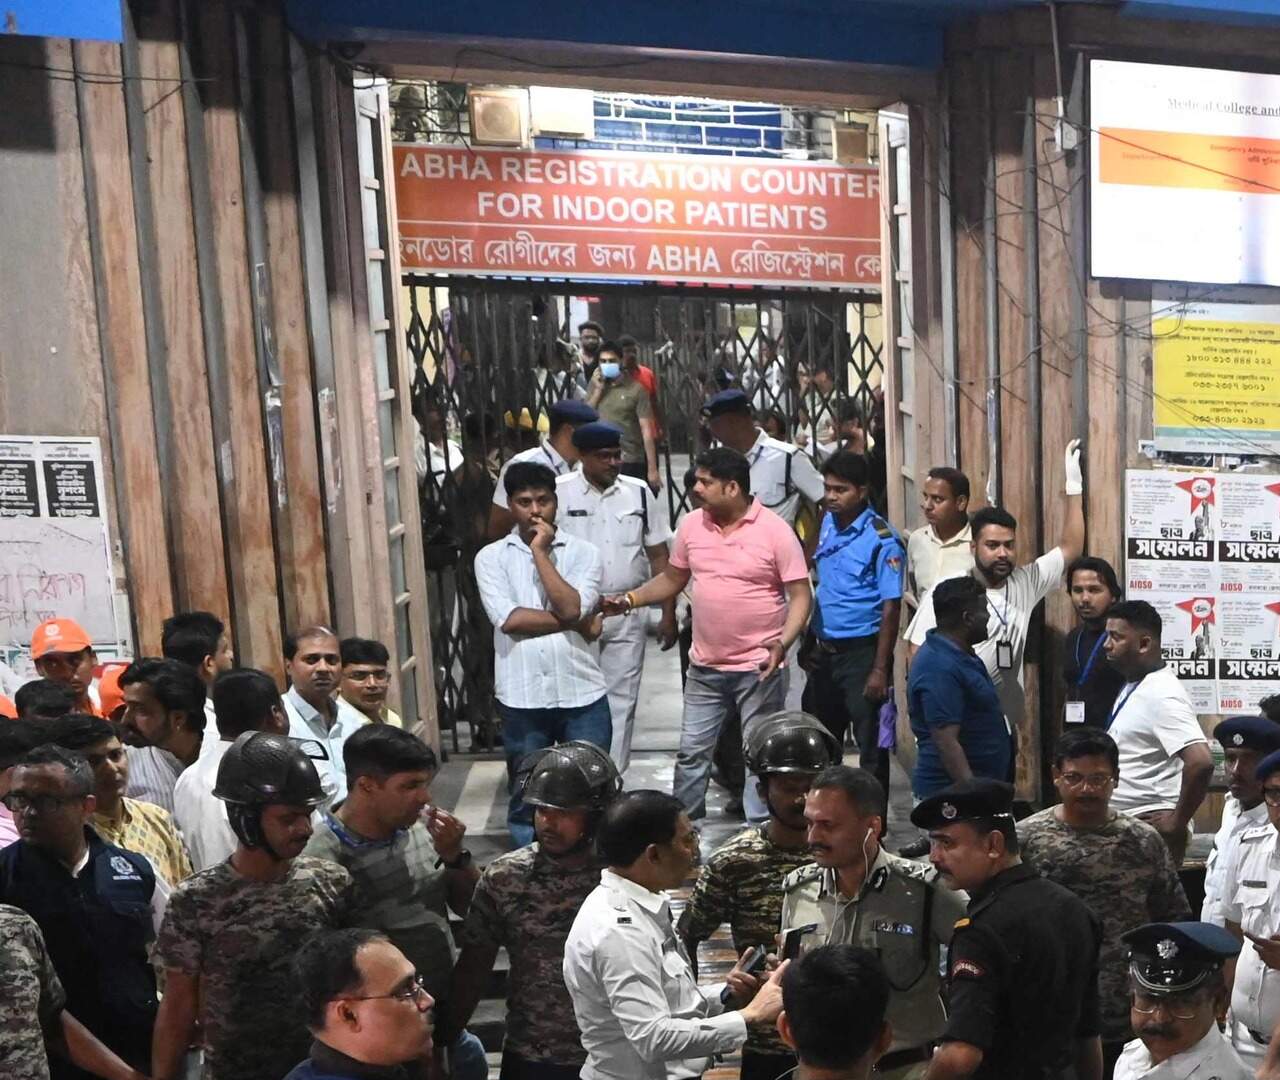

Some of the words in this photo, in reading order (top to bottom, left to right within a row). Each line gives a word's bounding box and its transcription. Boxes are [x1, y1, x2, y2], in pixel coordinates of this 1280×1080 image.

[1216, 100, 1258, 118] College
[401, 152, 492, 181] ABHA
[501, 157, 731, 193] REGISTRATION
[741, 167, 880, 199] COUNTER
[478, 191, 543, 219] FOR
[553, 195, 675, 225] INDOOR
[685, 200, 828, 231] PATIENTS
[485, 231, 577, 267] রোগীদের
[588, 242, 636, 270] জন্য
[647, 245, 721, 273] ABHA
[1160, 527, 1183, 539] ছাত্র
[1250, 529, 1272, 541] ছাত্র
[1136, 538, 1208, 559] সম্মেলন
[1129, 580, 1152, 590] AIDSO
[1220, 582, 1243, 592] AIDSO
[1250, 648, 1272, 659] ছাত্র
[1220, 699, 1243, 709] AIDSO
